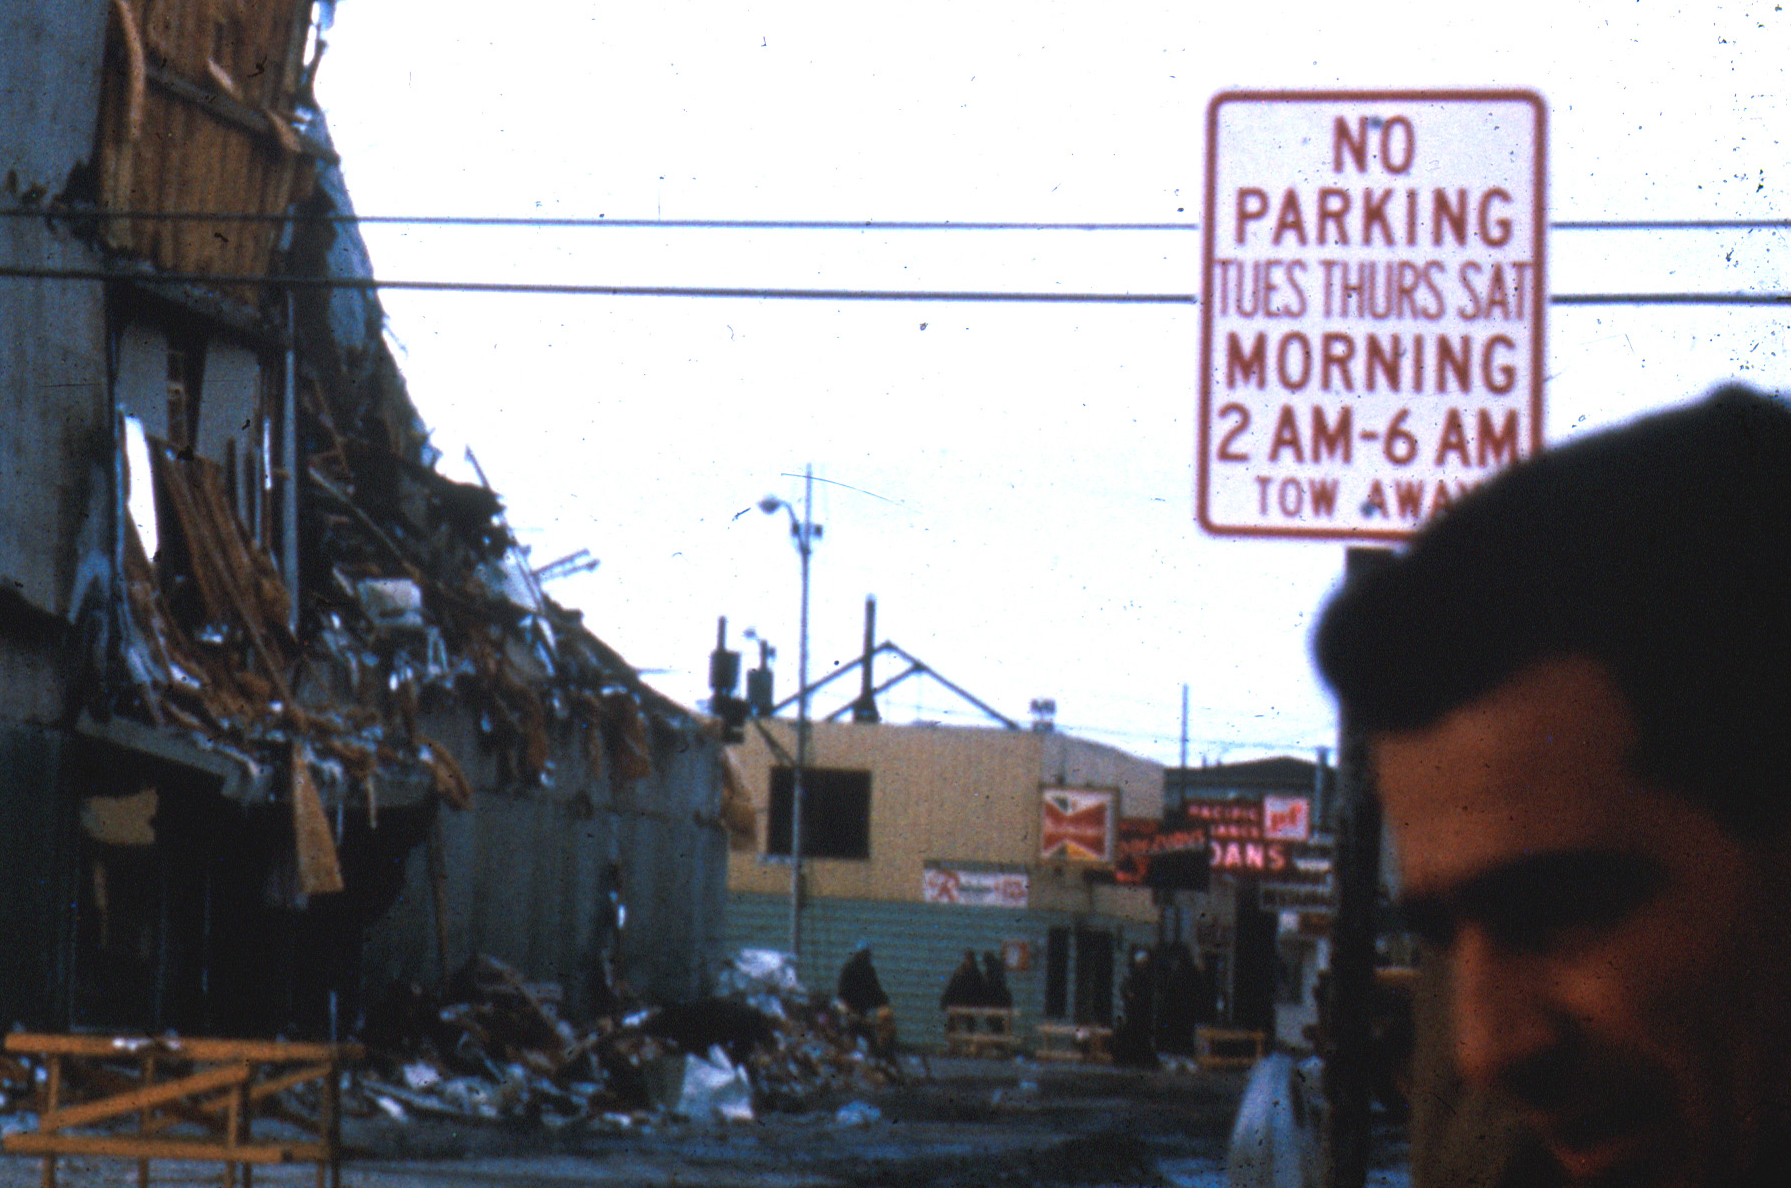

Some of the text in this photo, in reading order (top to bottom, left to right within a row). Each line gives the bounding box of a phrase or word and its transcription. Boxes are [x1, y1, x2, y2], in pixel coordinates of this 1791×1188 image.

[1332, 114, 1416, 174] NO
[1235, 187, 1513, 247] PARKING
[1215, 259, 1533, 322] TUES THURS SAT
[1226, 331, 1516, 395] MORNING
[1256, 476, 1481, 519] TOW AWA
